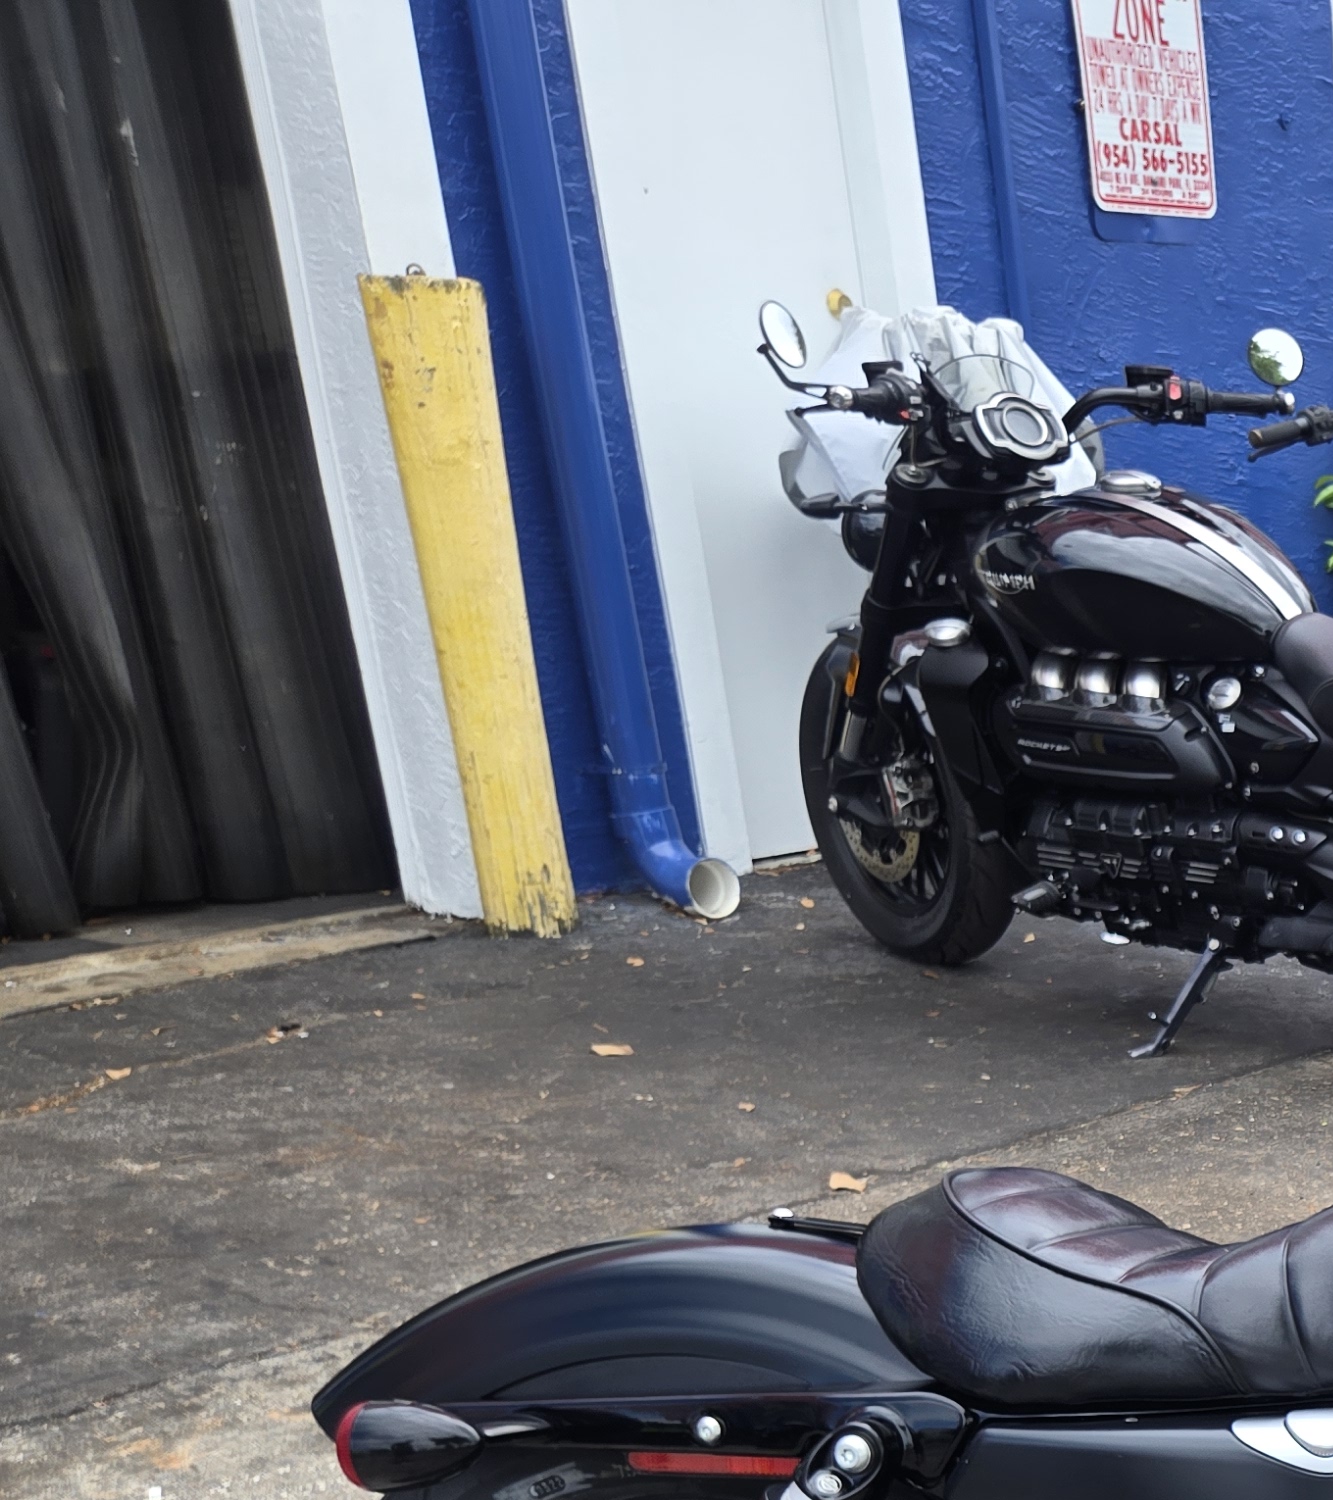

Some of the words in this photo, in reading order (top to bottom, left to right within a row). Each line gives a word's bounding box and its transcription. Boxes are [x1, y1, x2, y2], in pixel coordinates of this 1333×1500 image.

[1113, 0, 1170, 46] ZONE
[1119, 117, 1183, 147] CARSAL
[1097, 141, 1137, 171] (954)
[1143, 148, 1209, 176] 566-5155
